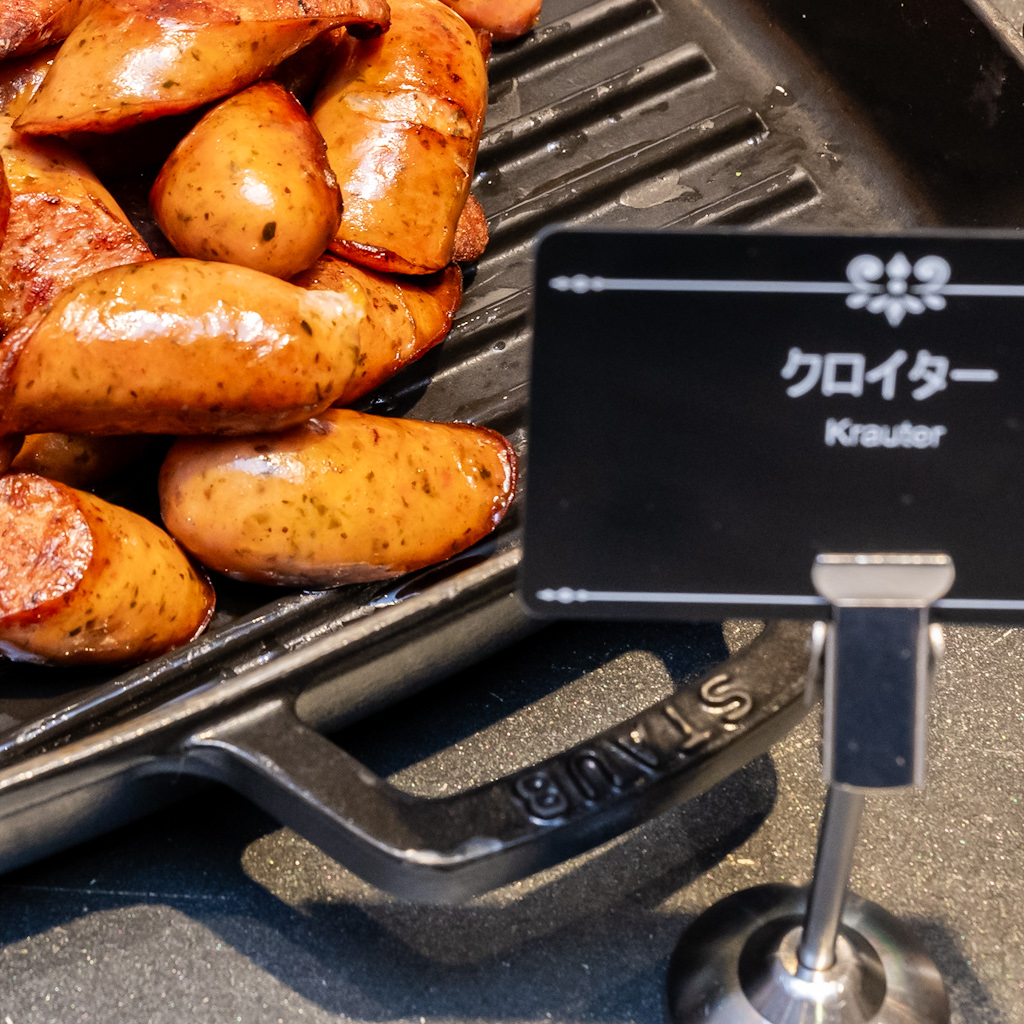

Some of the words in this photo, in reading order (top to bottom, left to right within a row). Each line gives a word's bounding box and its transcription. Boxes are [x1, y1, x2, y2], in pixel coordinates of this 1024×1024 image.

[780, 346, 999, 401] クロイター
[513, 674, 753, 827] STAUB
